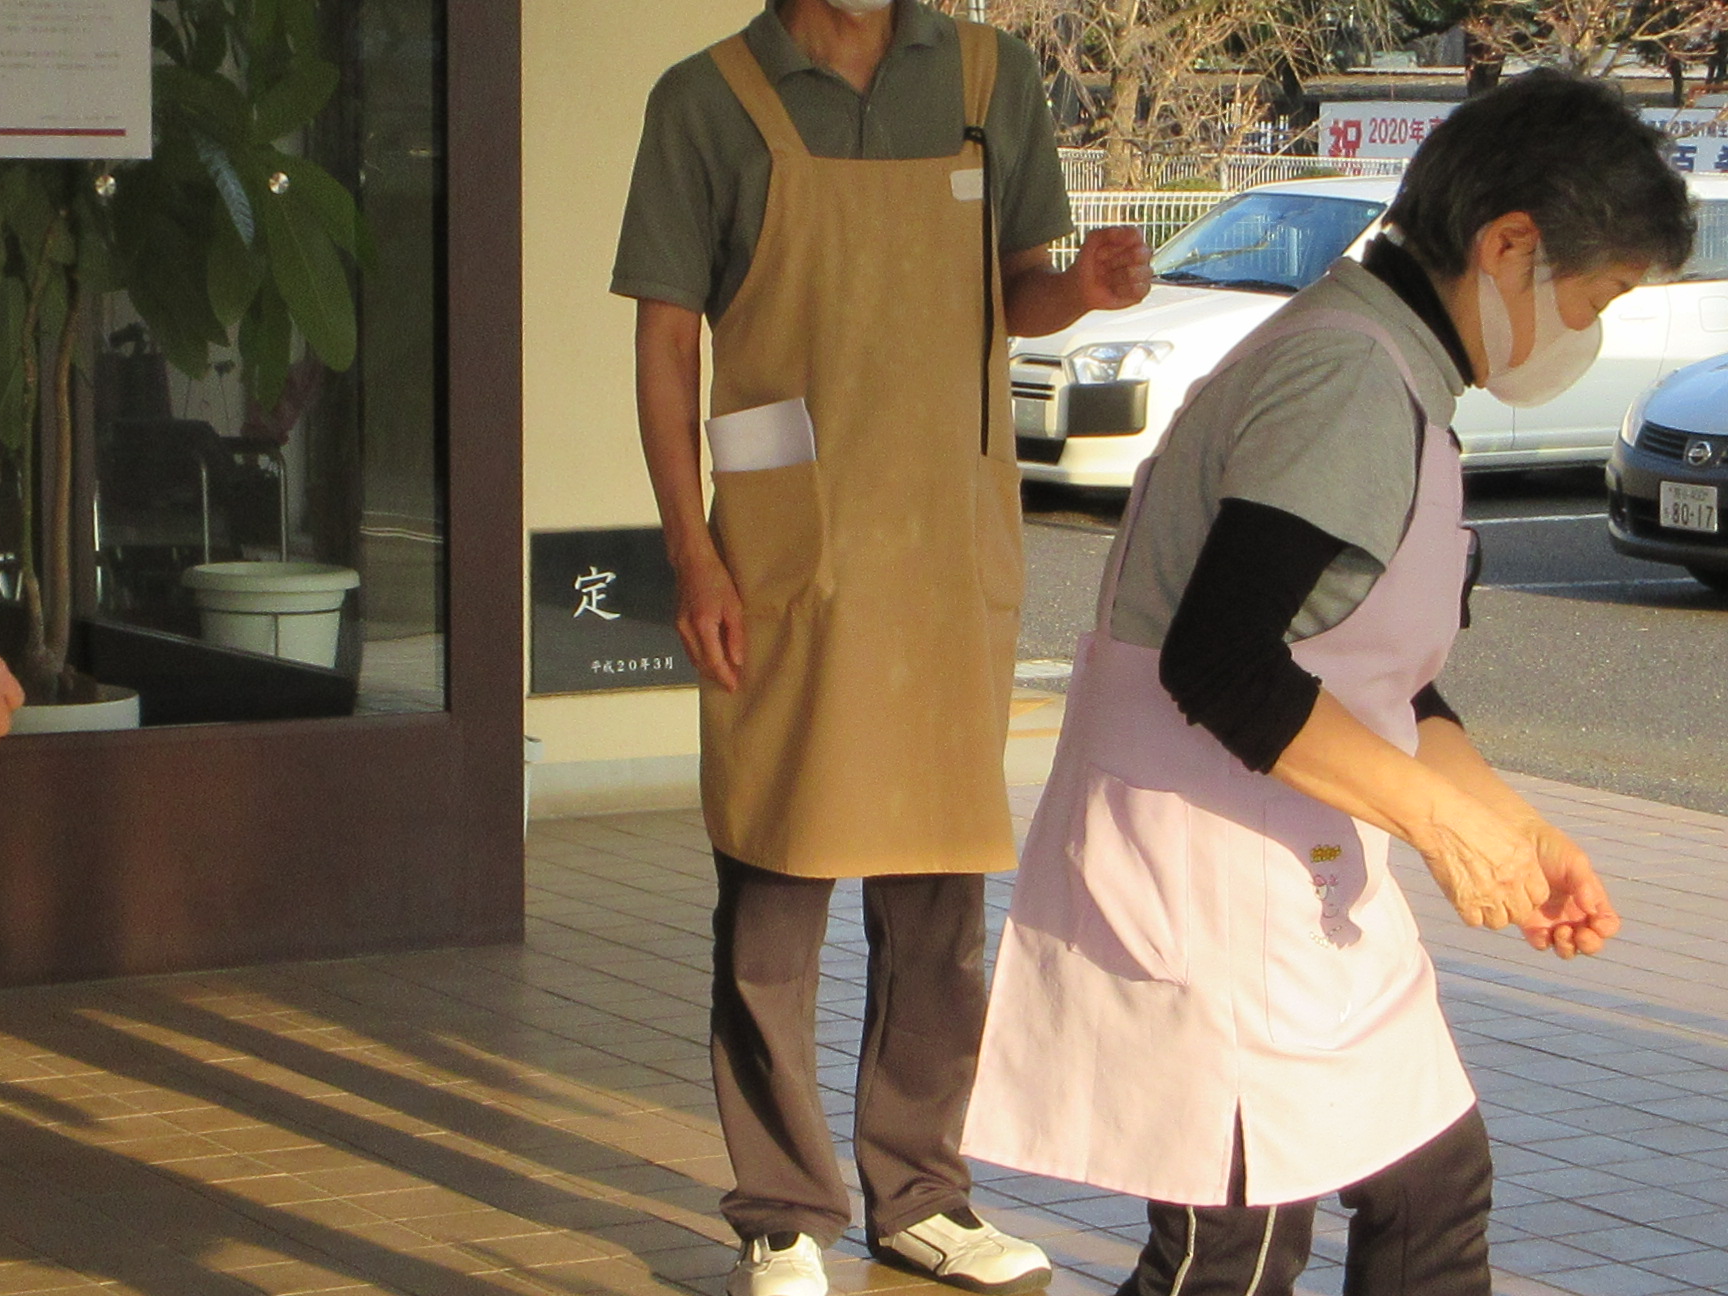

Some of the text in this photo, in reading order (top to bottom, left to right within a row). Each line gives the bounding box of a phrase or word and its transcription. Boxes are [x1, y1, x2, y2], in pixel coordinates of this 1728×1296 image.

[1328, 119, 1363, 170] 祝
[1368, 116, 1444, 145] 2020年
[1672, 502, 1714, 528] 80-17
[573, 565, 622, 621] 定
[590, 656, 674, 674] 平成20年3月
